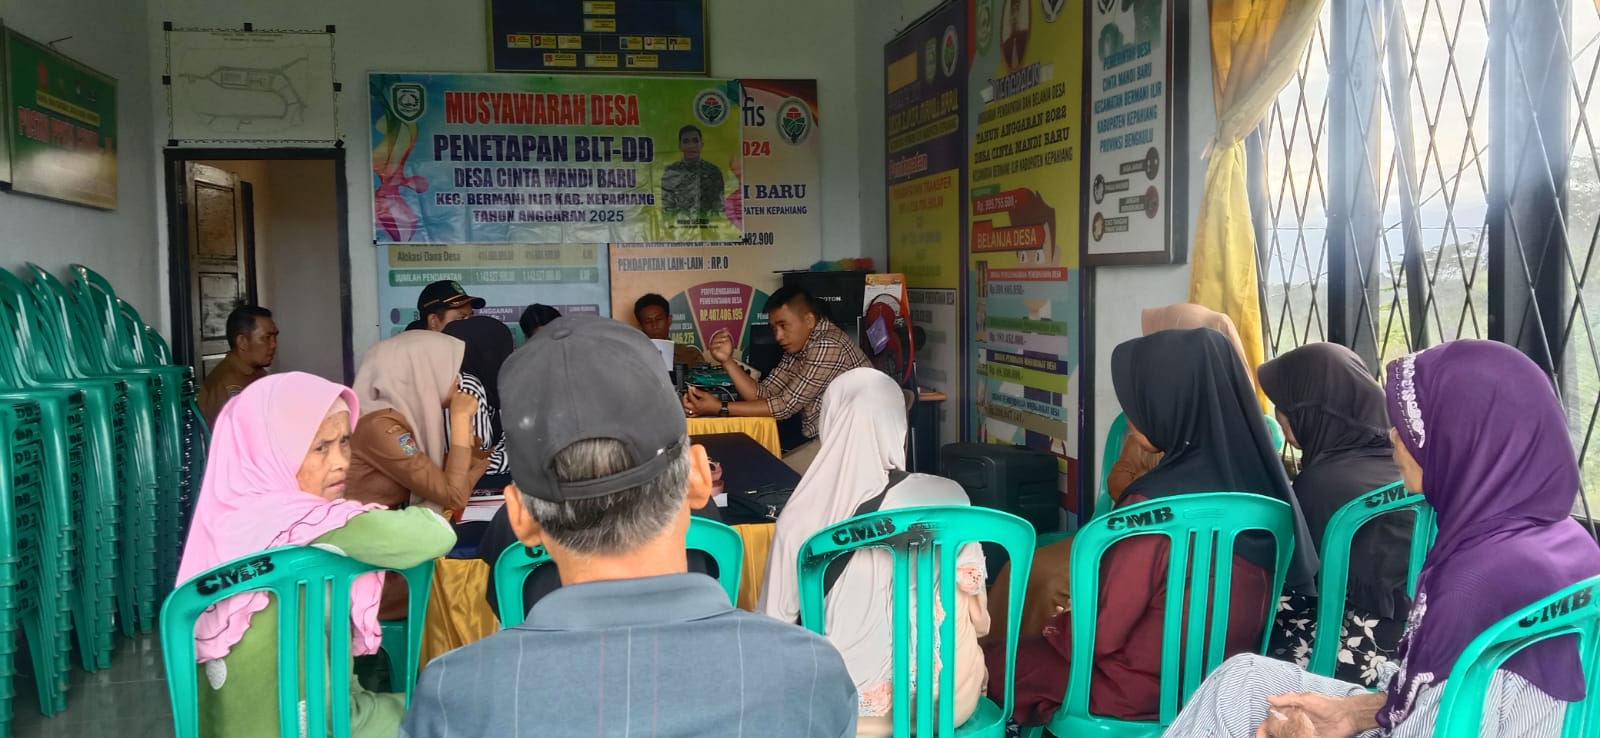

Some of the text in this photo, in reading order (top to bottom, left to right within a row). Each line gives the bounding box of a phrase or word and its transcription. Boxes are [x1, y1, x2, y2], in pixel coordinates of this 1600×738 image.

[1137, 40, 1152, 58] DESA
[1118, 67, 1136, 86] MANDI
[1137, 62, 1152, 80] BARU
[1124, 85, 1150, 106] BERMANI
[445, 92, 639, 126] MUSYAWARAH DESA
[1097, 104, 1157, 134] KABUPATEN KEPAHIANG
[976, 127, 999, 145] TAHUN
[1000, 112, 1044, 138] ANGGARAN
[1045, 104, 1067, 124] 2022
[434, 134, 654, 162] PENETAPAN BLT-DD
[743, 141, 770, 156] 024
[991, 143, 1014, 160] CINTA
[1015, 134, 1042, 154] MANDI
[1044, 126, 1070, 146] BARU
[1100, 127, 1154, 153] PROVINSI BENGKULU
[454, 167, 636, 188] DESA CINTA MANDI BARU
[436, 193, 656, 205] KEC. BERMANI ILIR KAB. KEPAHIANG
[755, 184, 806, 199] BARU
[472, 210, 624, 222] TAHUN ANGGARAN 2025
[766, 205, 807, 215] KEPAHIANG
[977, 228, 1037, 249] BELANJA DESA
[424, 251, 442, 262] Dana
[443, 251, 461, 261] Desa
[617, 258, 666, 272] PENDAPATAN
[667, 256, 704, 270] LAIN-LAIN
[1364, 486, 1409, 508] CM
[1106, 506, 1175, 530] CMB
[831, 517, 896, 546] CMB
[196, 555, 274, 596] CMB
[1518, 586, 1593, 628] CMB
